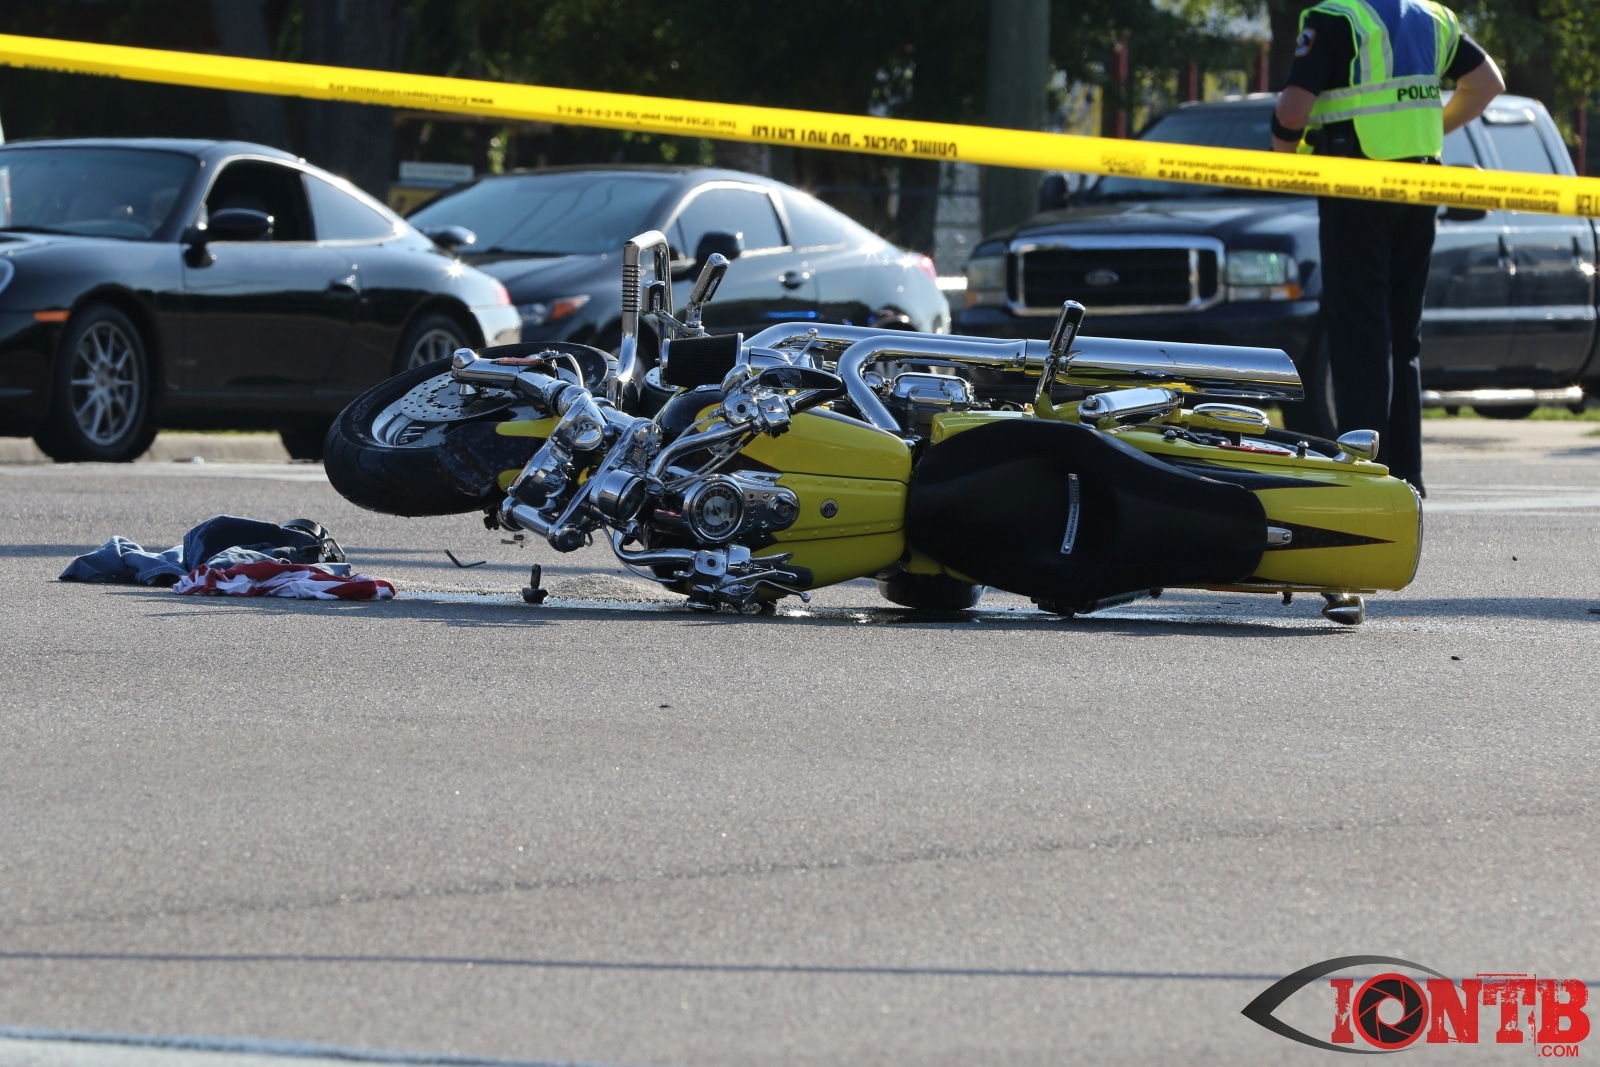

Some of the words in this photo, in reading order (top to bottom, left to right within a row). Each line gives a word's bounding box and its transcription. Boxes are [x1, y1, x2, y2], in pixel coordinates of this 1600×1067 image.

[751, 125, 795, 141] ENTER
[801, 129, 827, 143] NOT
[831, 132, 850, 146] DO
[863, 135, 908, 151] SCENE
[912, 139, 958, 157] CRIME
